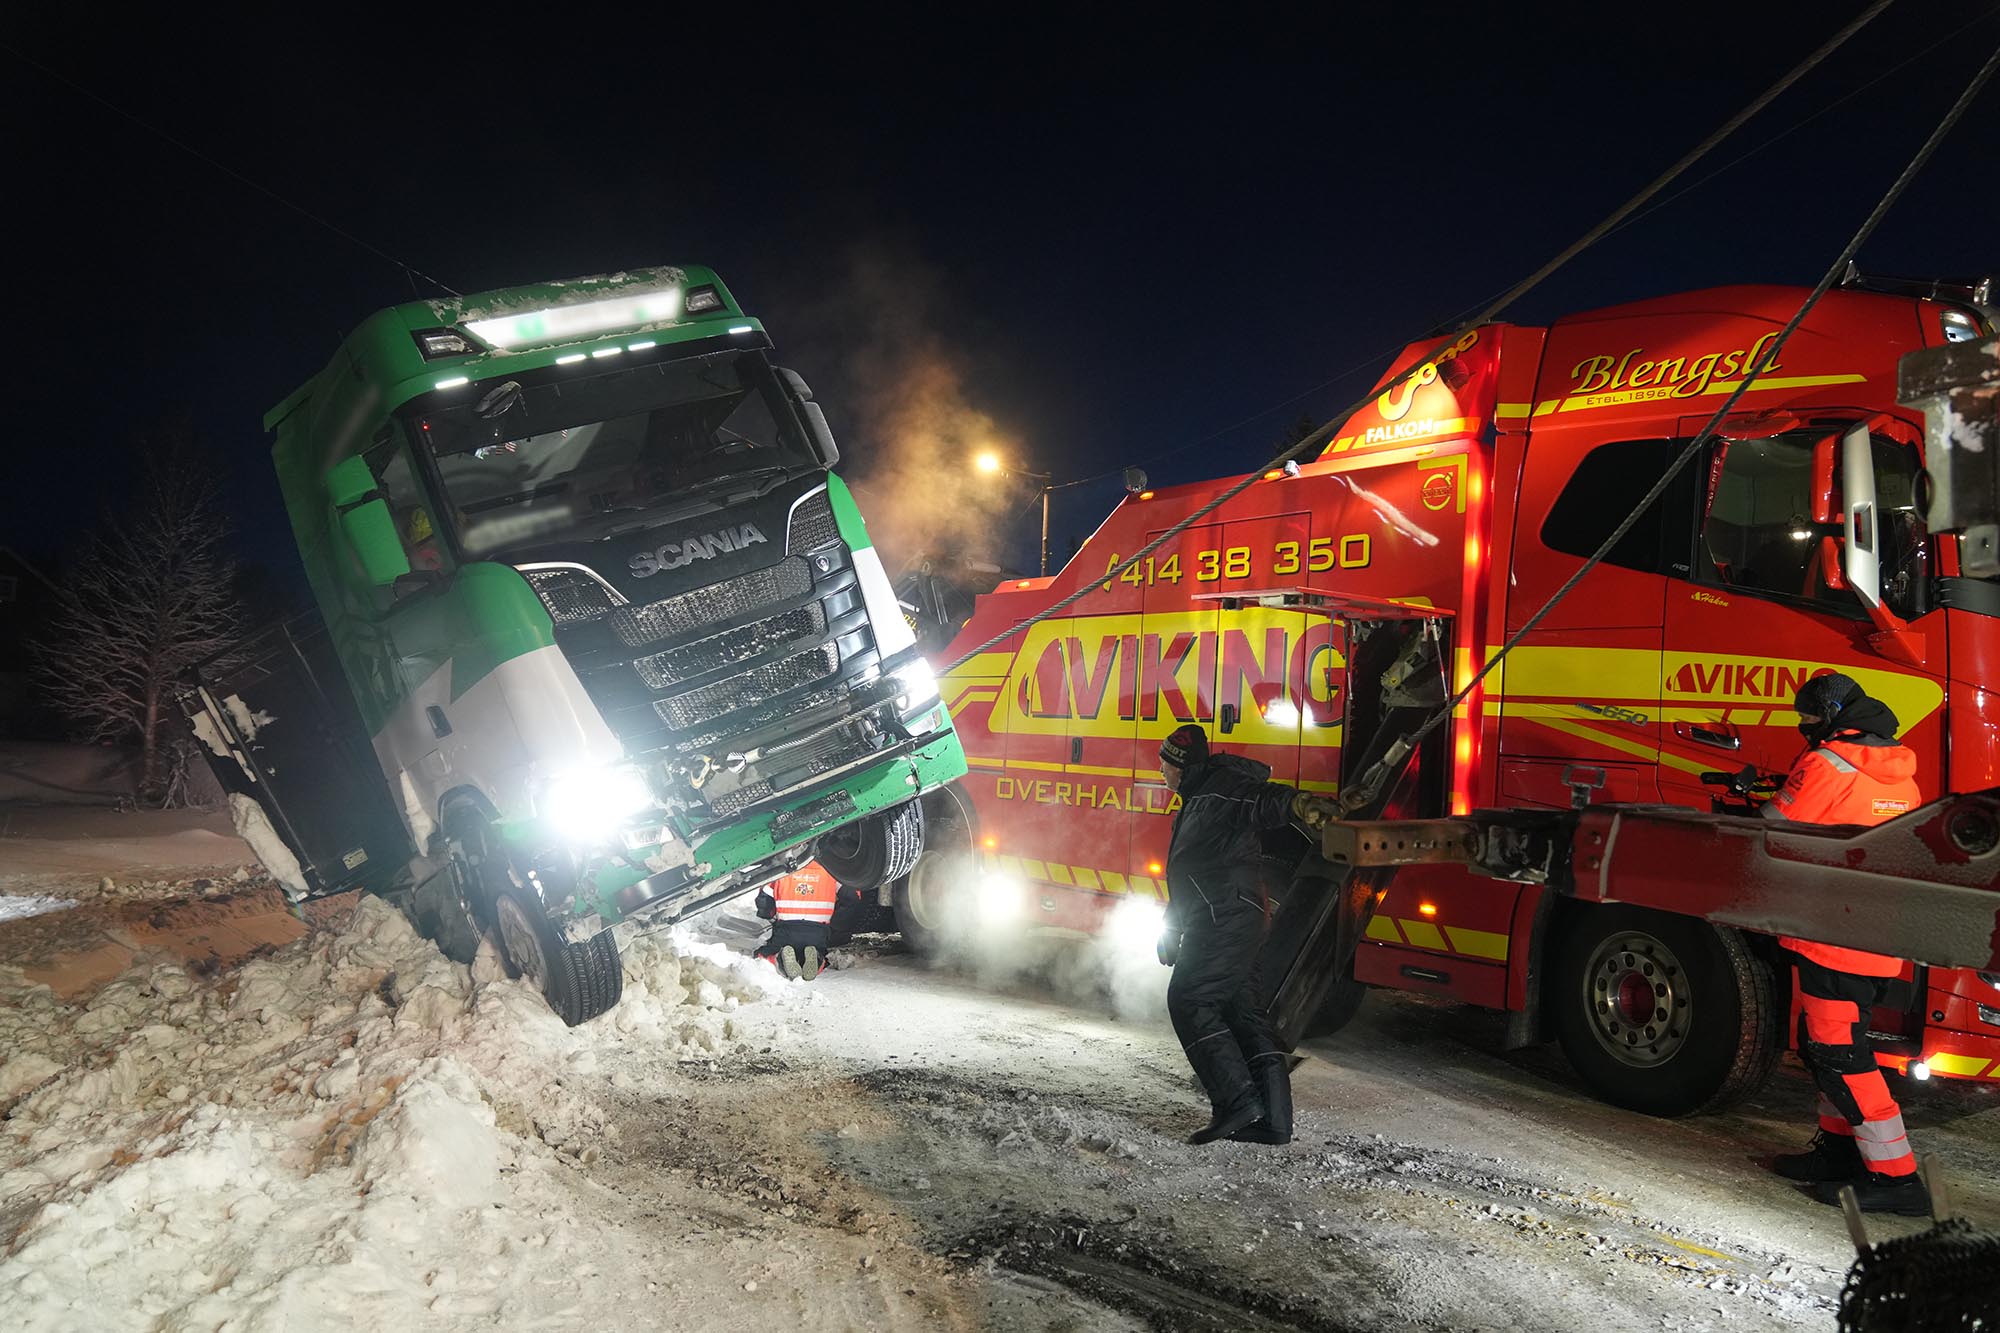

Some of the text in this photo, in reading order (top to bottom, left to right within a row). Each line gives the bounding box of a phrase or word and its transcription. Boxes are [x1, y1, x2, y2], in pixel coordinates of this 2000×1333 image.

[1571, 331, 1784, 399] Blengsli
[1629, 388, 1667, 401] 1896
[1365, 418, 1434, 444] FALKOM
[628, 522, 769, 579] SCANIA
[1120, 533, 1372, 588] 414 38 350
[1066, 623, 1345, 728] VIKING
[1694, 663, 1838, 698] VIKIN
[1603, 705, 1649, 727] 650
